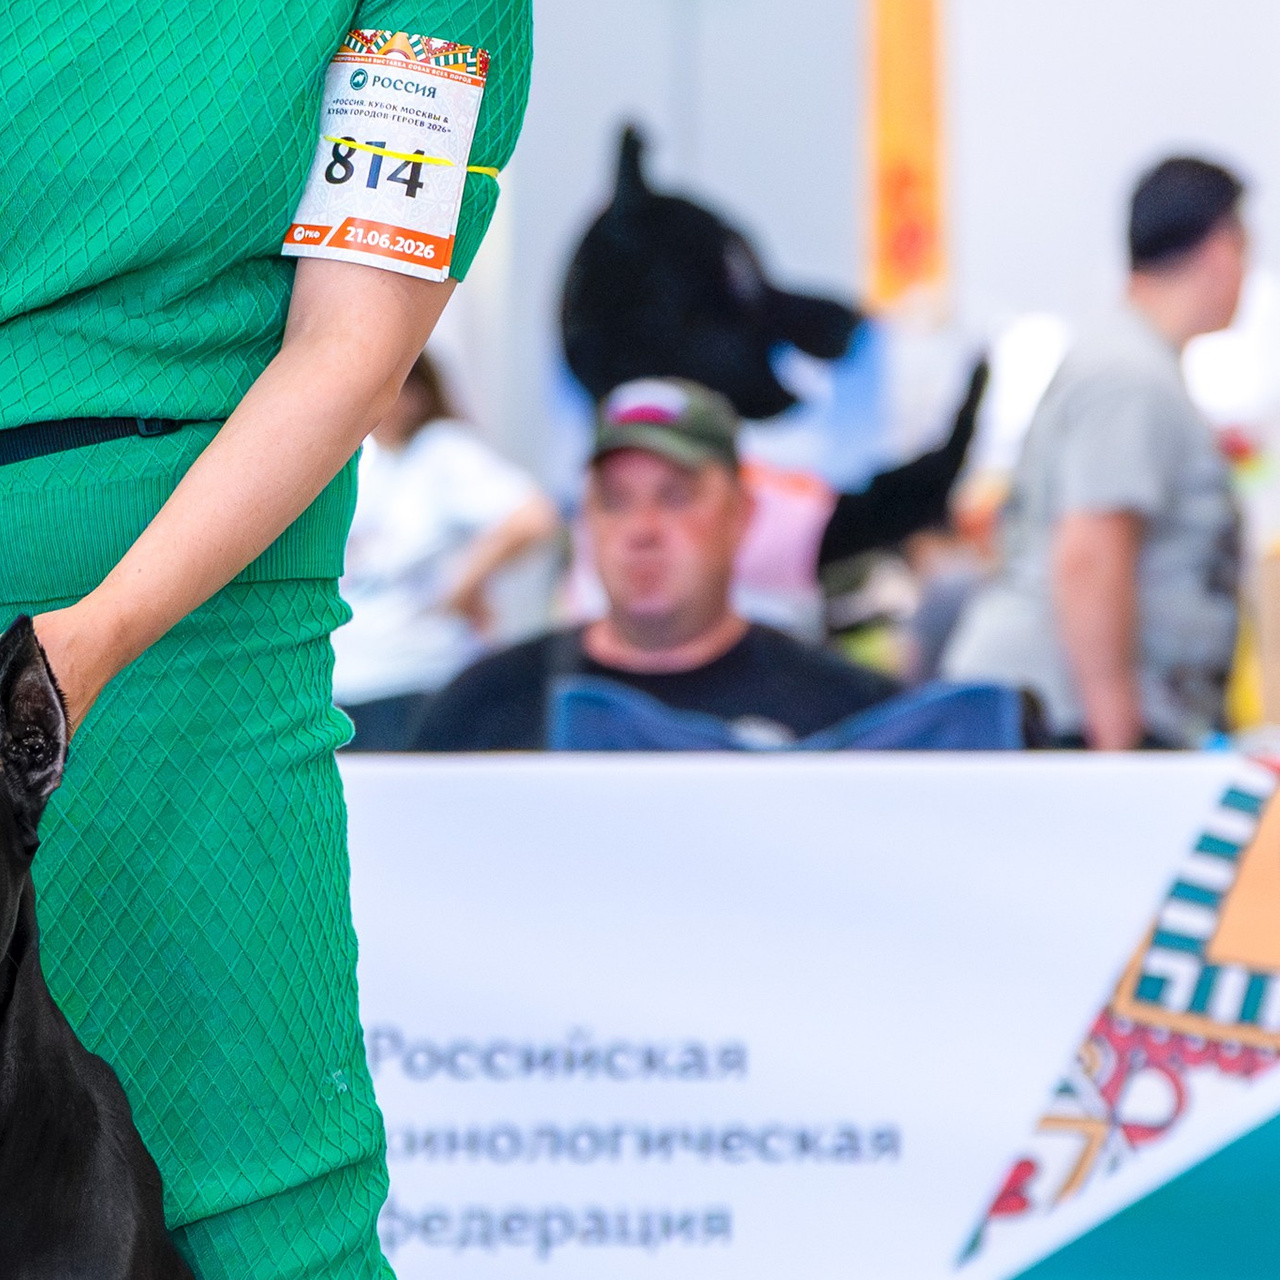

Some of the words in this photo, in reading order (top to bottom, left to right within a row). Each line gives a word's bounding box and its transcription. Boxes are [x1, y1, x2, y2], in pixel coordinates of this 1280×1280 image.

[372, 75, 437, 99] РОССИЯ
[369, 101, 398, 112] КУБОК
[401, 106, 442, 121] МОСКВЫ
[325, 136, 425, 199] 814
[344, 226, 436, 259] 21.06.2026
[370, 1024, 750, 1082] Российская
